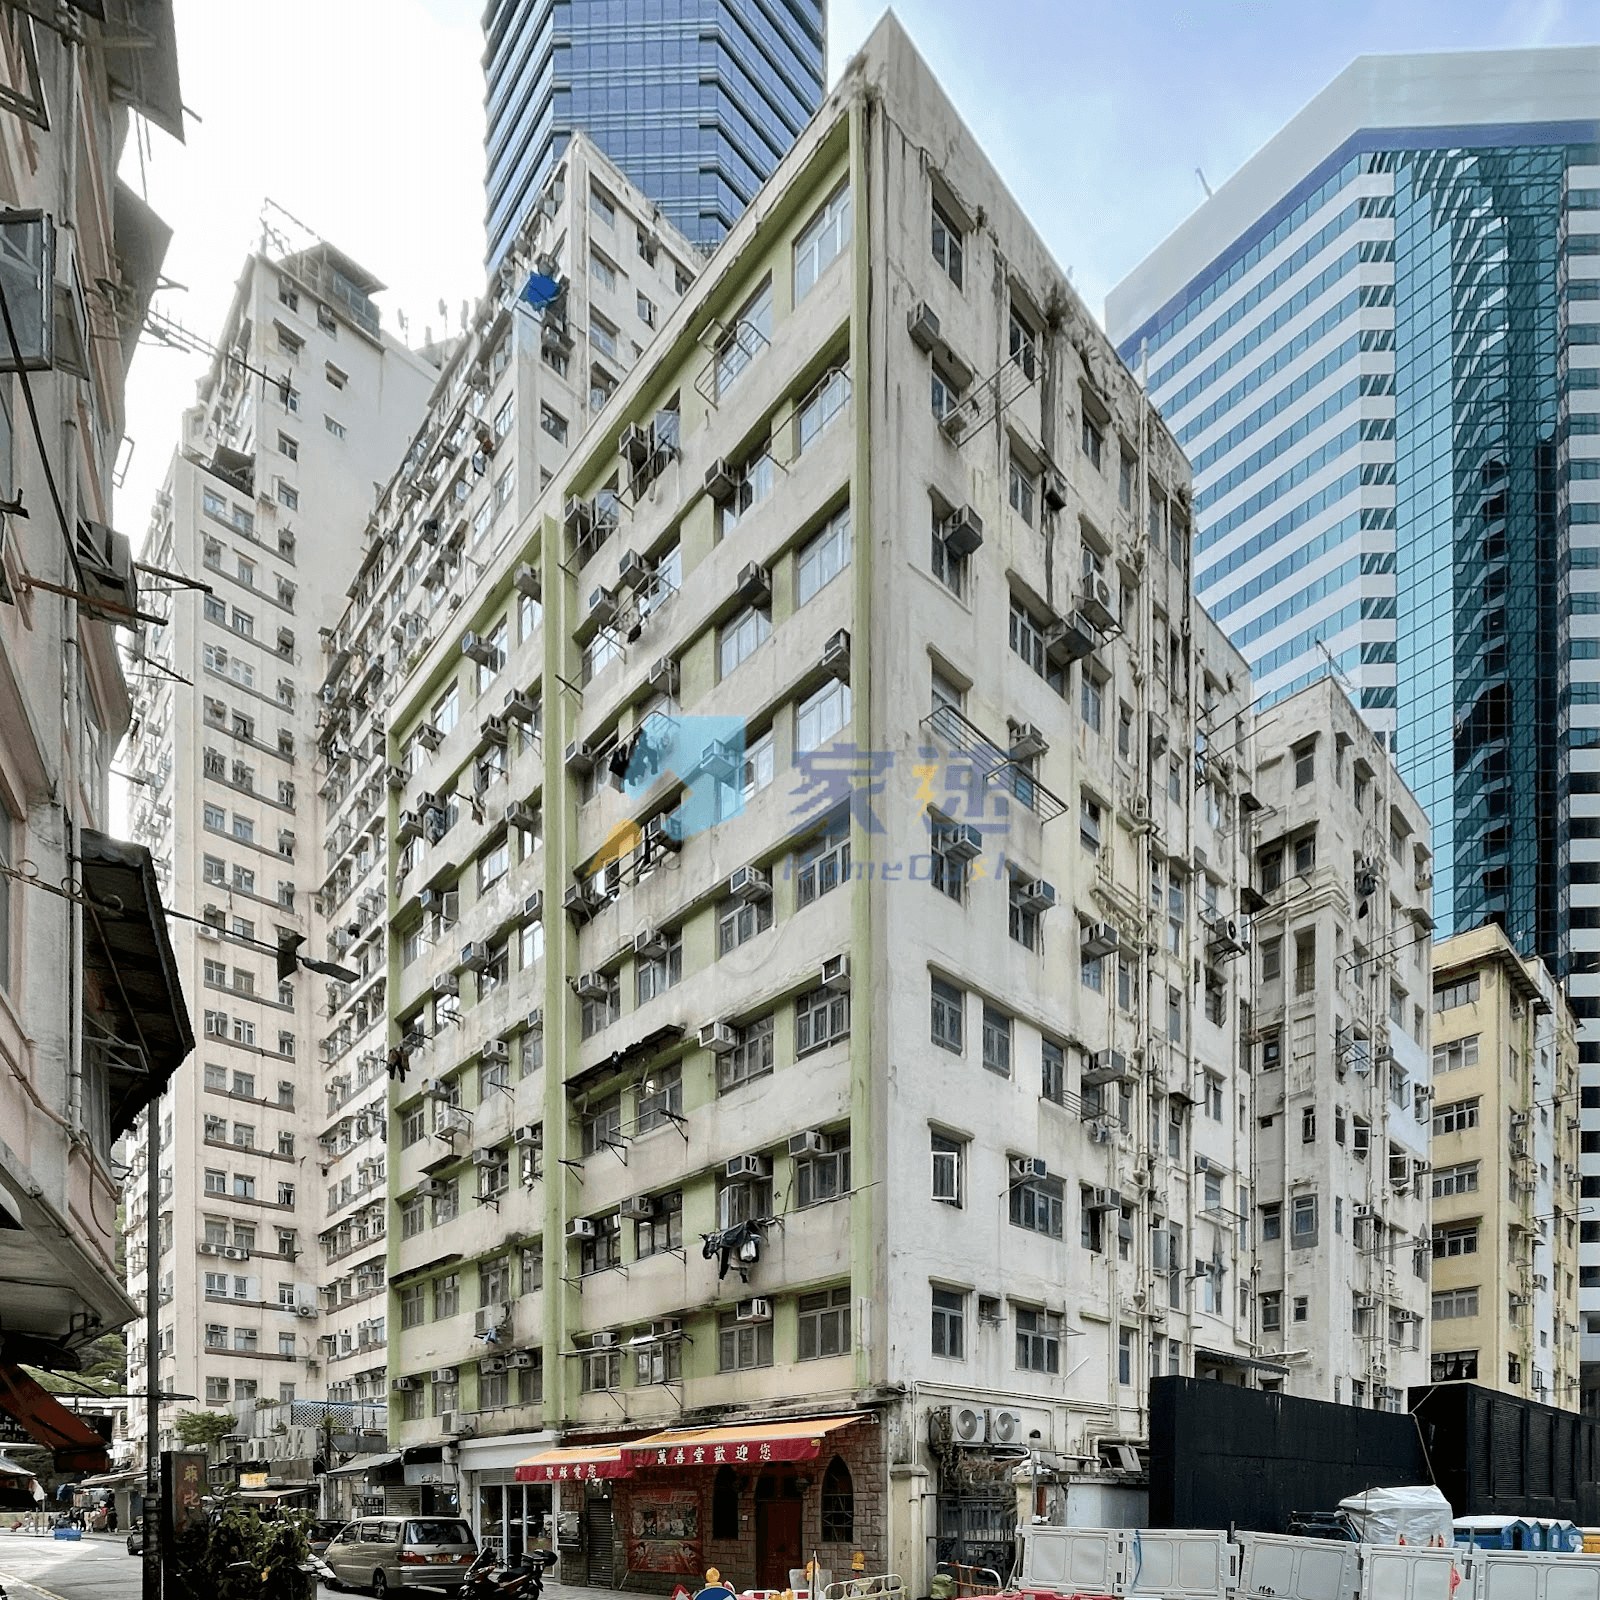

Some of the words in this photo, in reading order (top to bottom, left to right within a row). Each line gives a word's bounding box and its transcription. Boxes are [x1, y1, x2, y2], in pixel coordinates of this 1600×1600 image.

[657, 1443, 771, 1465] 萬善堂歡迎您
